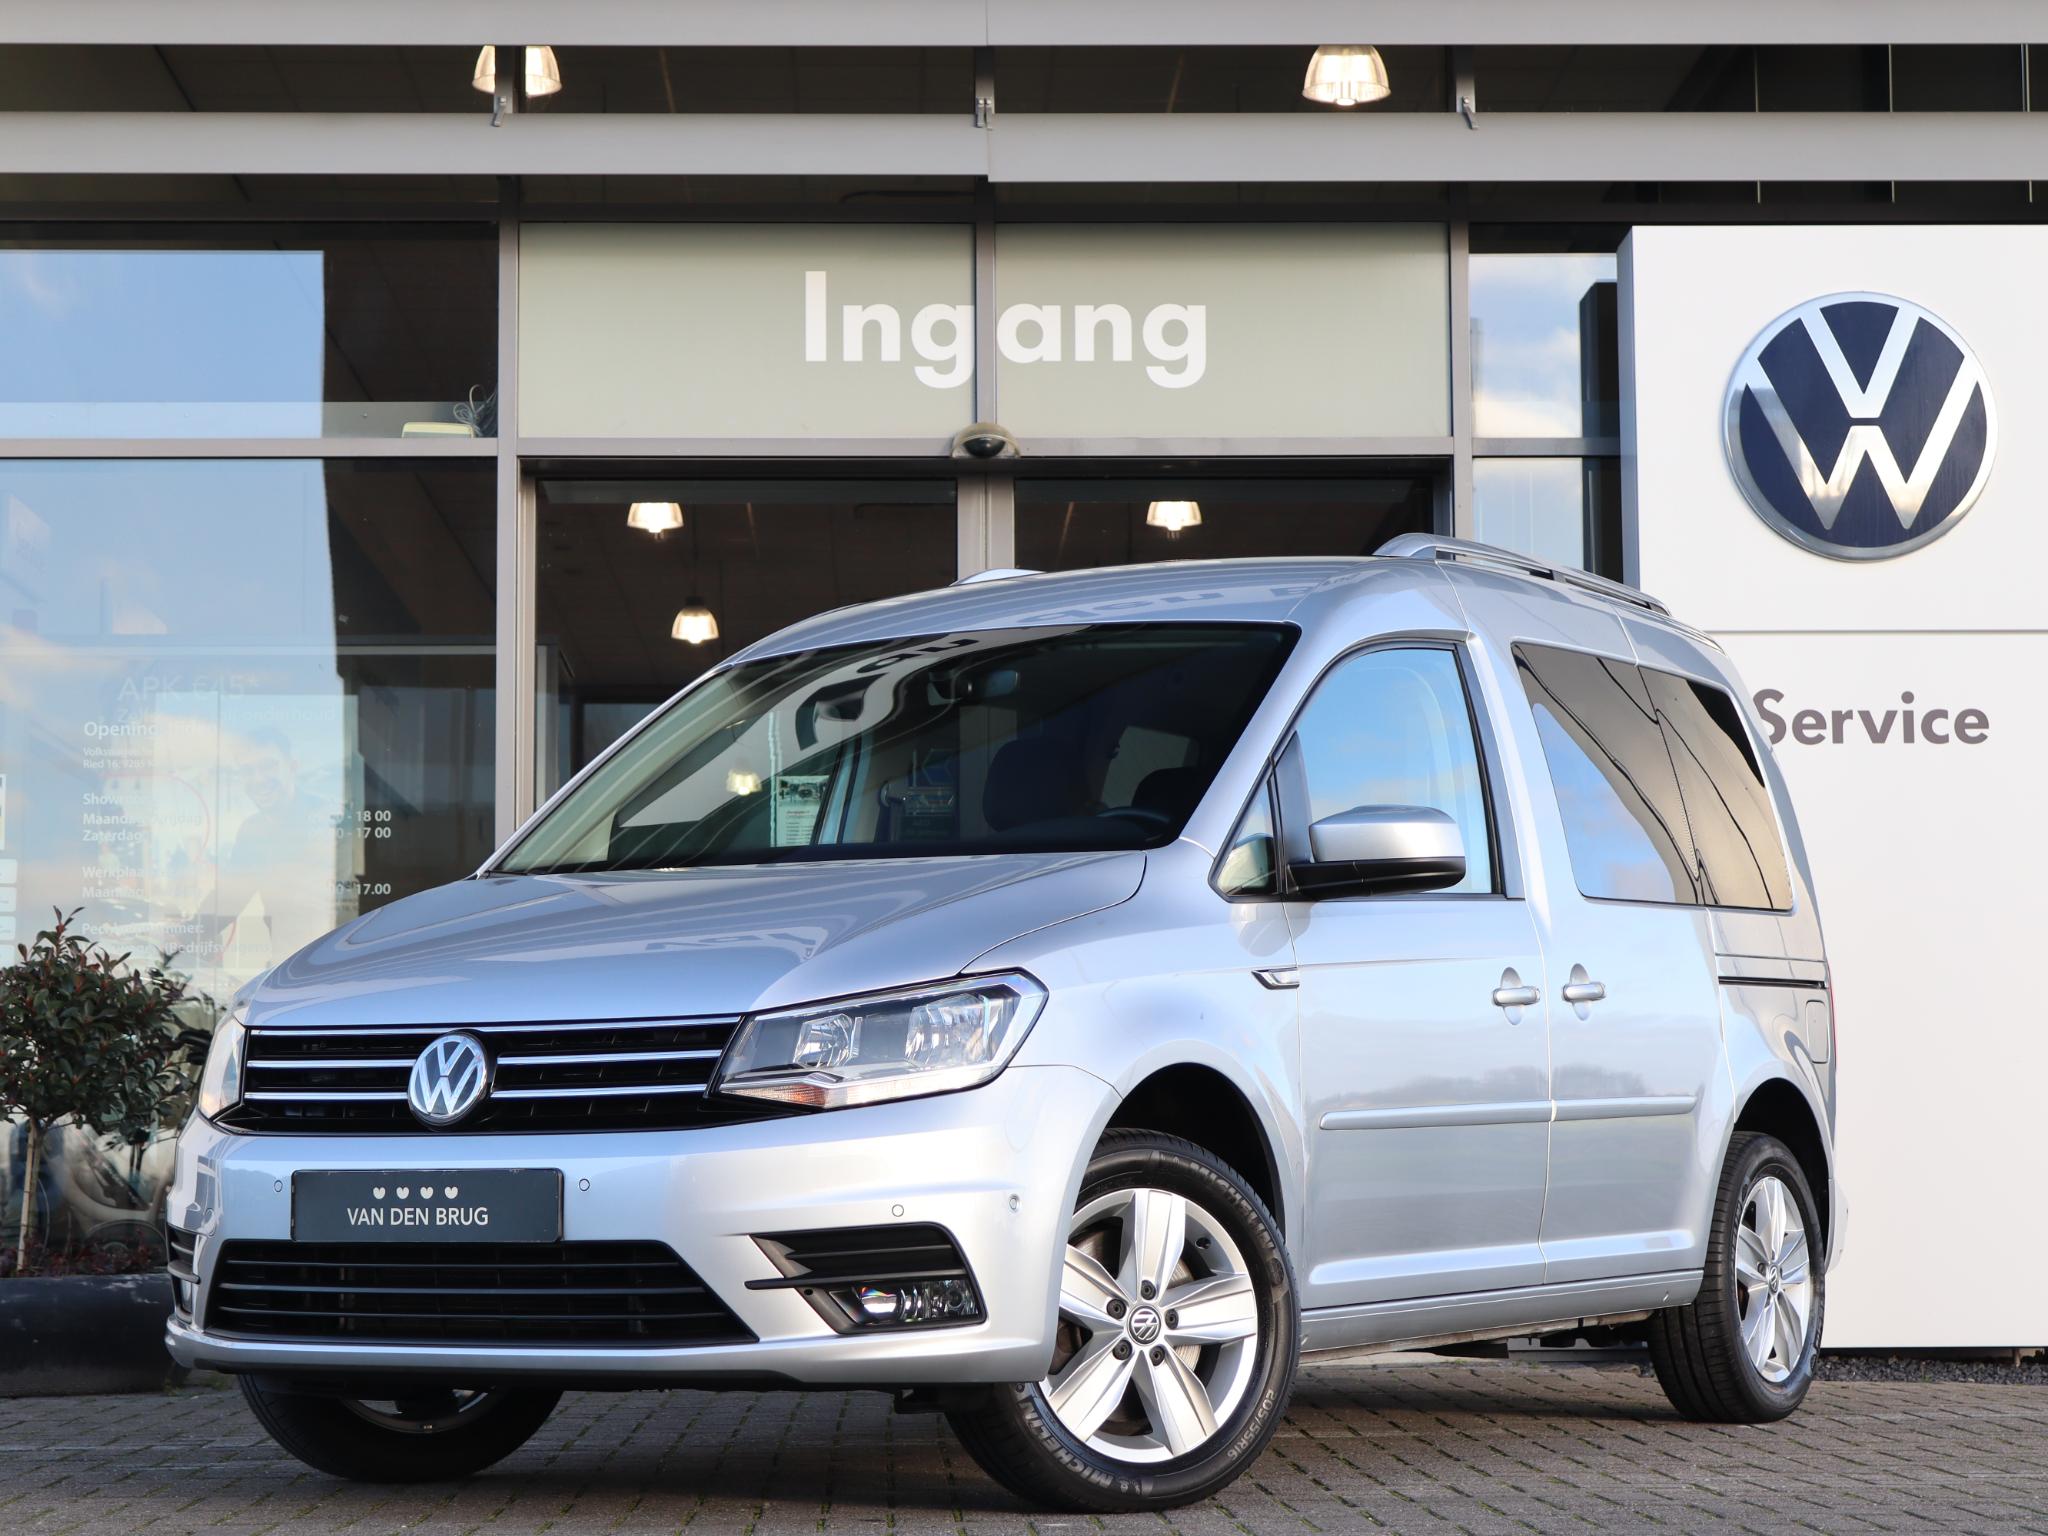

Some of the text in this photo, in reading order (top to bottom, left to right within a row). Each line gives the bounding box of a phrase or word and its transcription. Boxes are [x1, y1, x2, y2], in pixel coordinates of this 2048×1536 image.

[805, 271, 1207, 389] Ingang
[1753, 688, 1990, 746] Service
[356, 883, 391, 895] 17.00
[347, 1206, 489, 1227] VAN DEN BRUG
